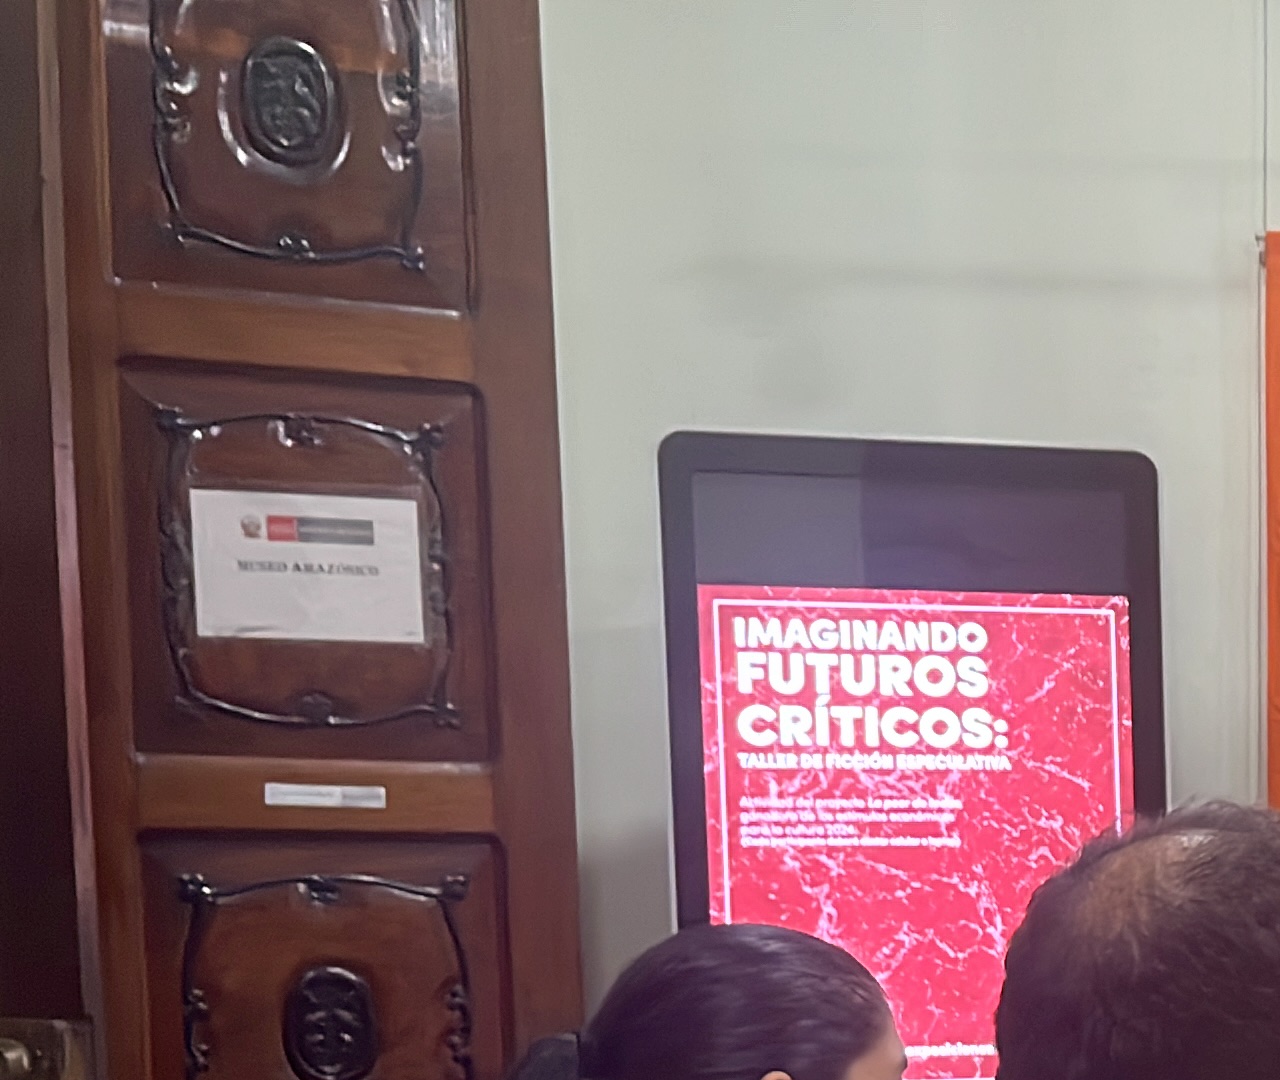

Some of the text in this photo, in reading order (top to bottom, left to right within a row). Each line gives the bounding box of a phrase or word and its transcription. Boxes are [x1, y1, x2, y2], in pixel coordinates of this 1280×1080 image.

[733, 616, 988, 653] IMAGINANDO
[737, 653, 989, 698] FUTUROS
[736, 694, 1010, 749] CRÍTICOS:
[738, 752, 1012, 771] TALLER DE FICCIÓN ESPECULATIVA
